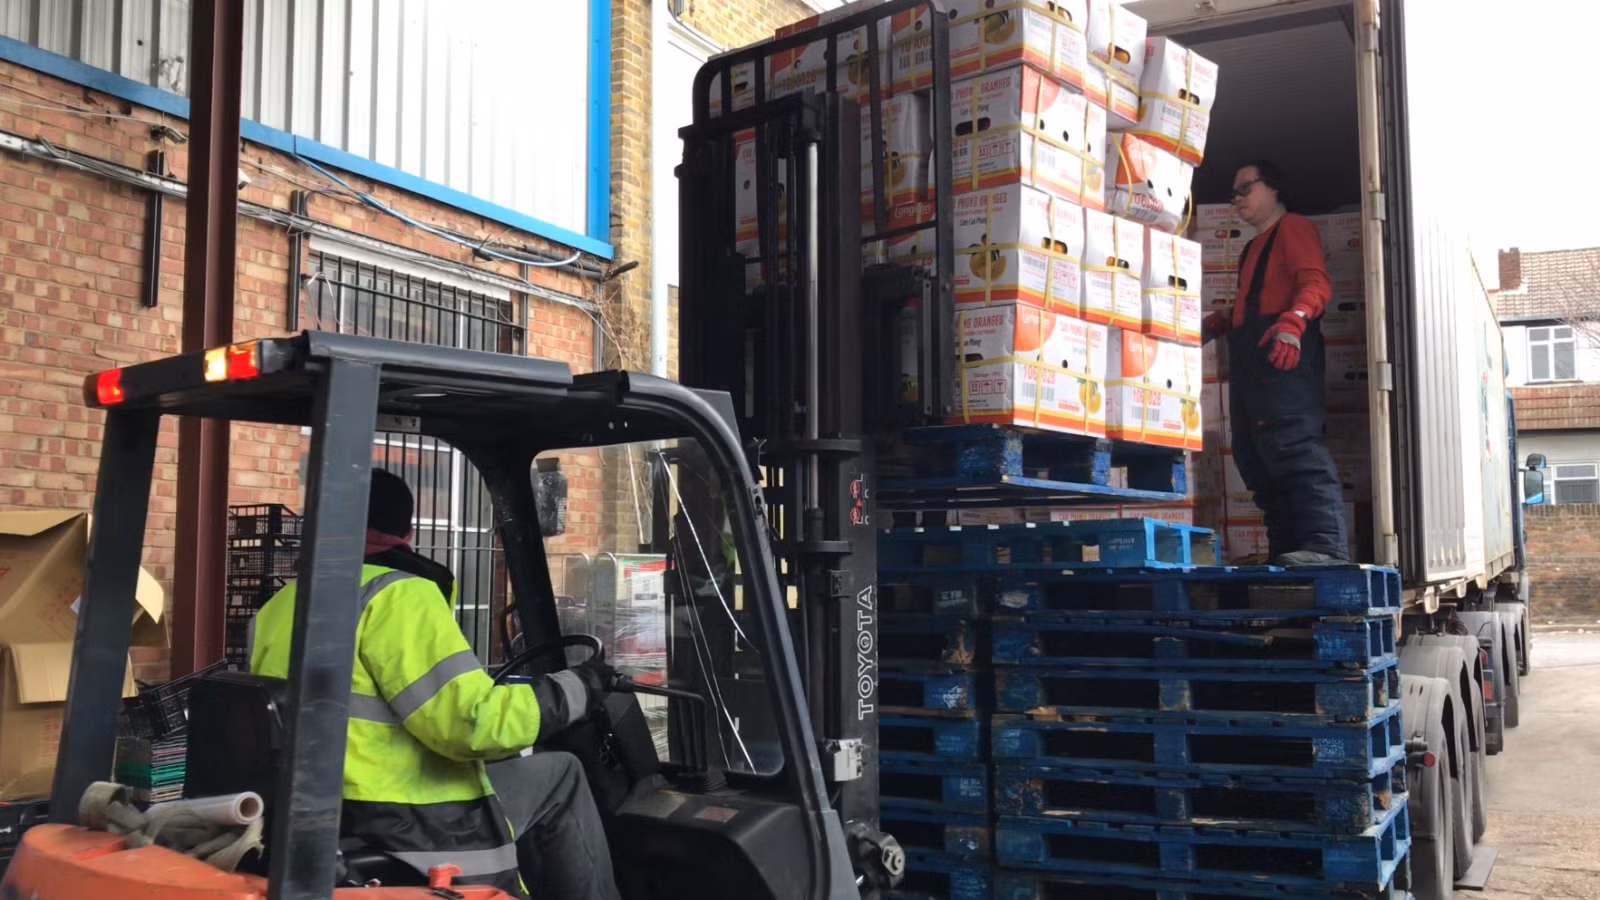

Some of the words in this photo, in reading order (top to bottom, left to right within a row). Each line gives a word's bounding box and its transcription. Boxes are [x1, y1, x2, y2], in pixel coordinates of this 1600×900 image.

[980, 77, 1010, 94] ORANGES
[980, 193, 1008, 206] ORGES
[895, 204, 930, 218] Longan
[974, 314, 1004, 328] ORANGES
[1024, 363, 1056, 384] 106028
[857, 585, 874, 721] TOYOTA
